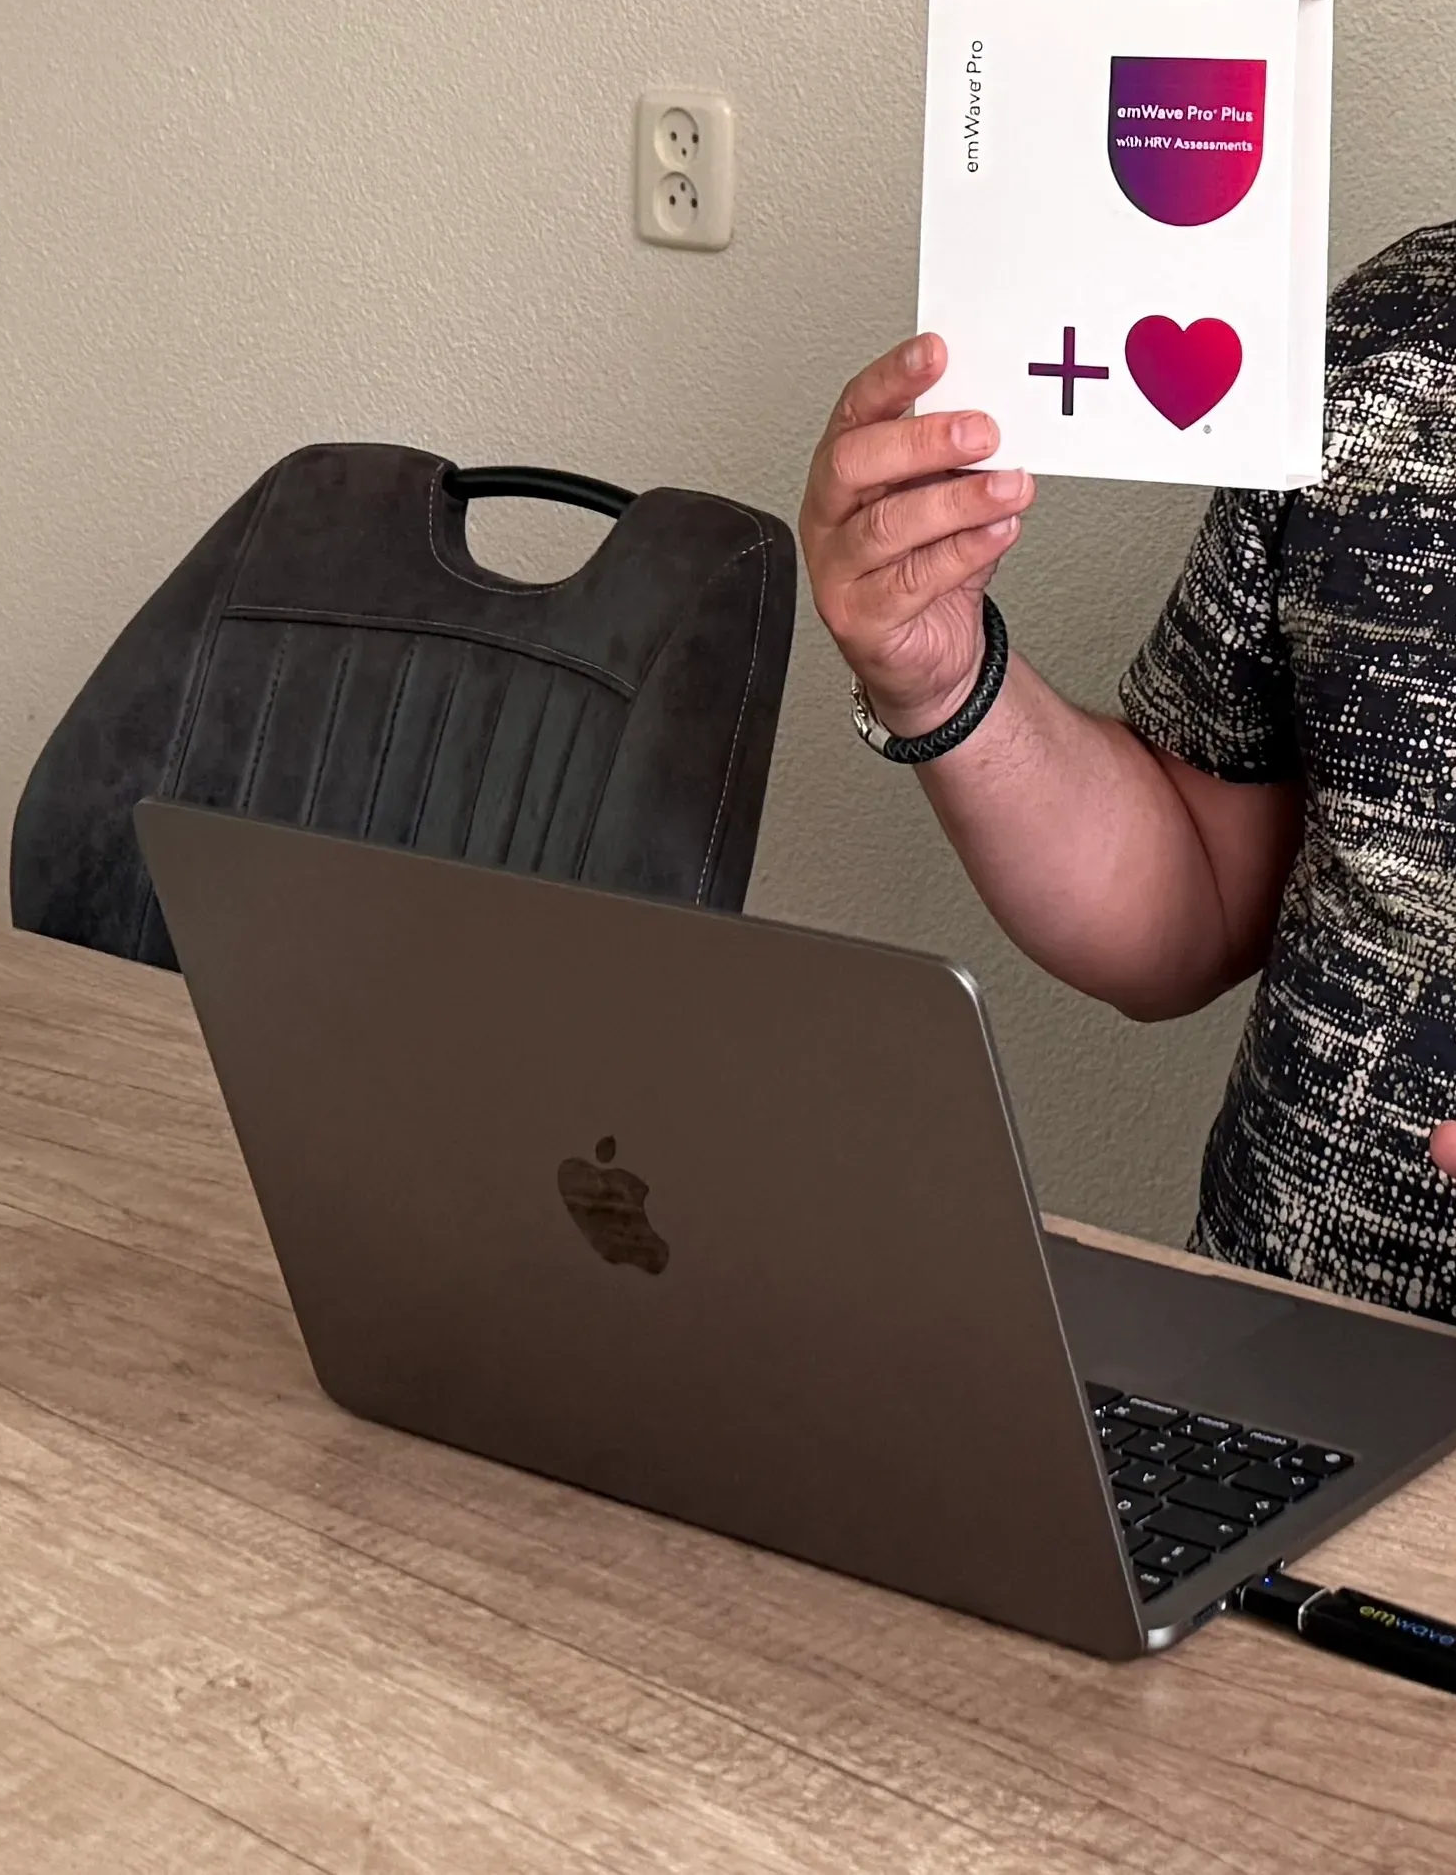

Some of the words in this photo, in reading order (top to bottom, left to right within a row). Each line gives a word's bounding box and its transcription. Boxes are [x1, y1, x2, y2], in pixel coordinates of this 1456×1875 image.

[965, 39, 984, 74] Pro
[1220, 106, 1254, 123] Plus
[1115, 135, 1143, 148] with
[1144, 136, 1173, 150] HRV
[1173, 136, 1254, 152] Assessments
